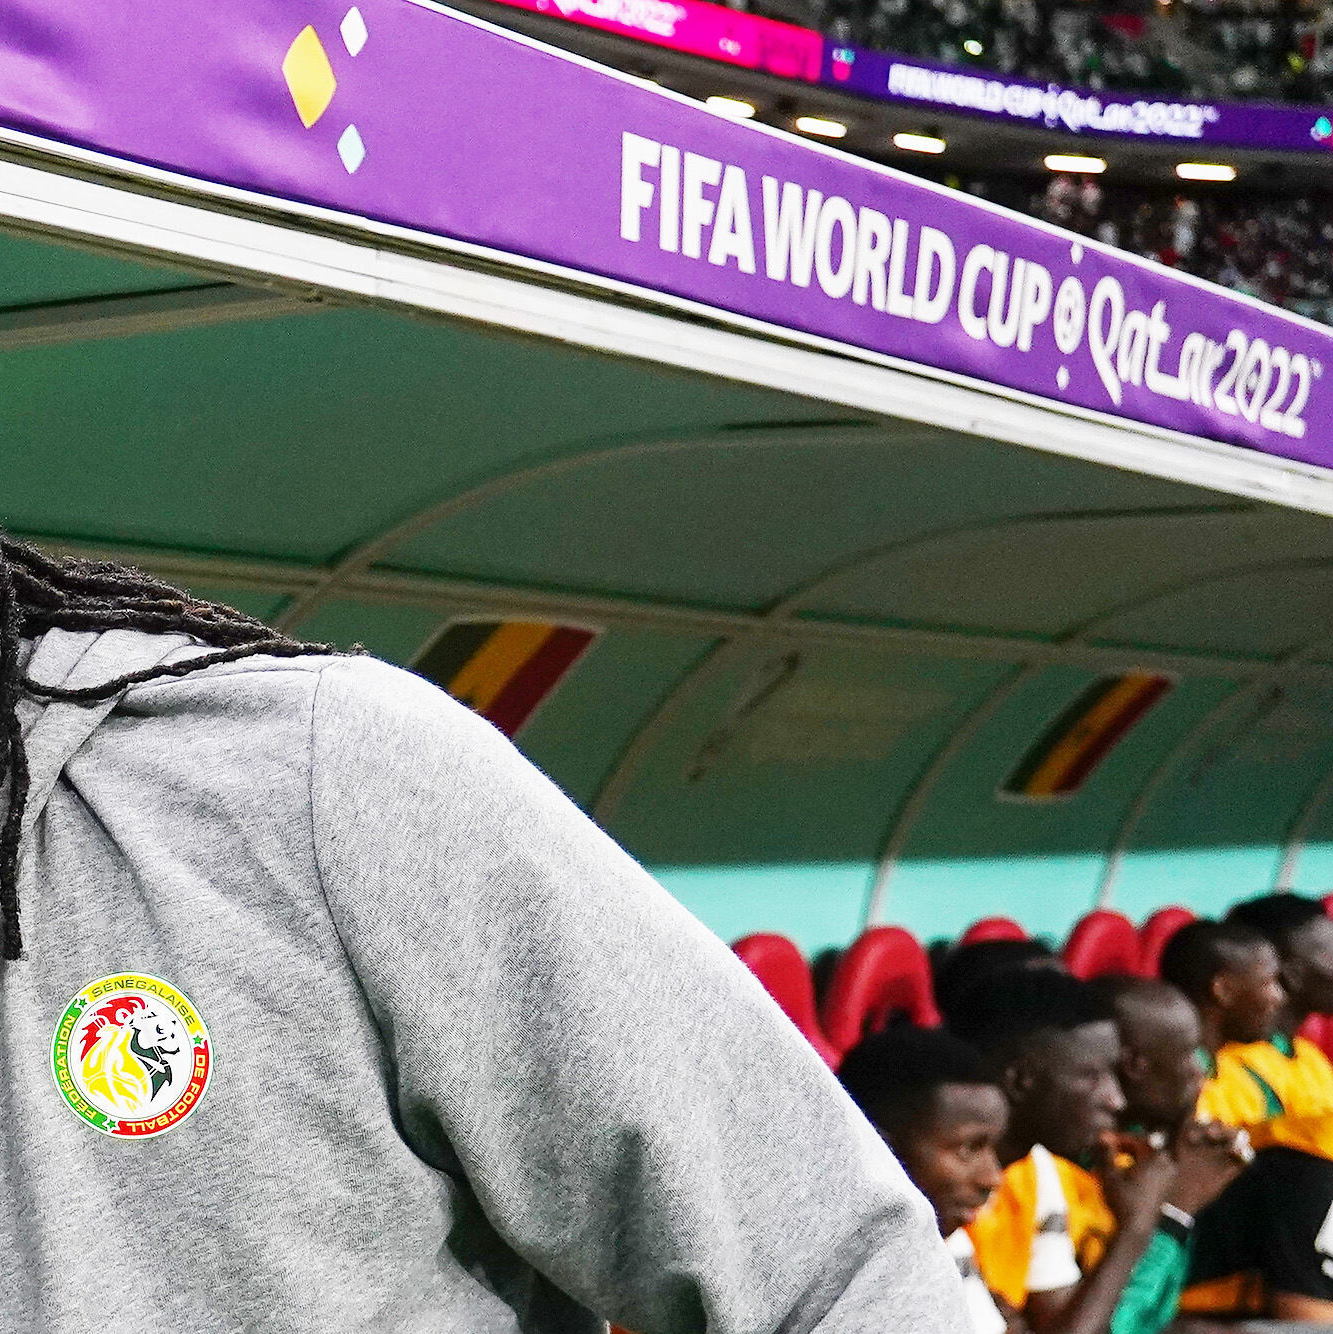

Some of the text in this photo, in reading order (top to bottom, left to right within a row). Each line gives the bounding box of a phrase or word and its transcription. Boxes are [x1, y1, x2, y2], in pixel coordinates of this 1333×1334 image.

[619, 130, 757, 274] FIFA
[762, 174, 956, 325] WORLD
[957, 243, 1053, 352] CUP
[56, 977, 206, 1133] FÉDÉRATION SÉNÉGALAISE DE FOOTBALL
